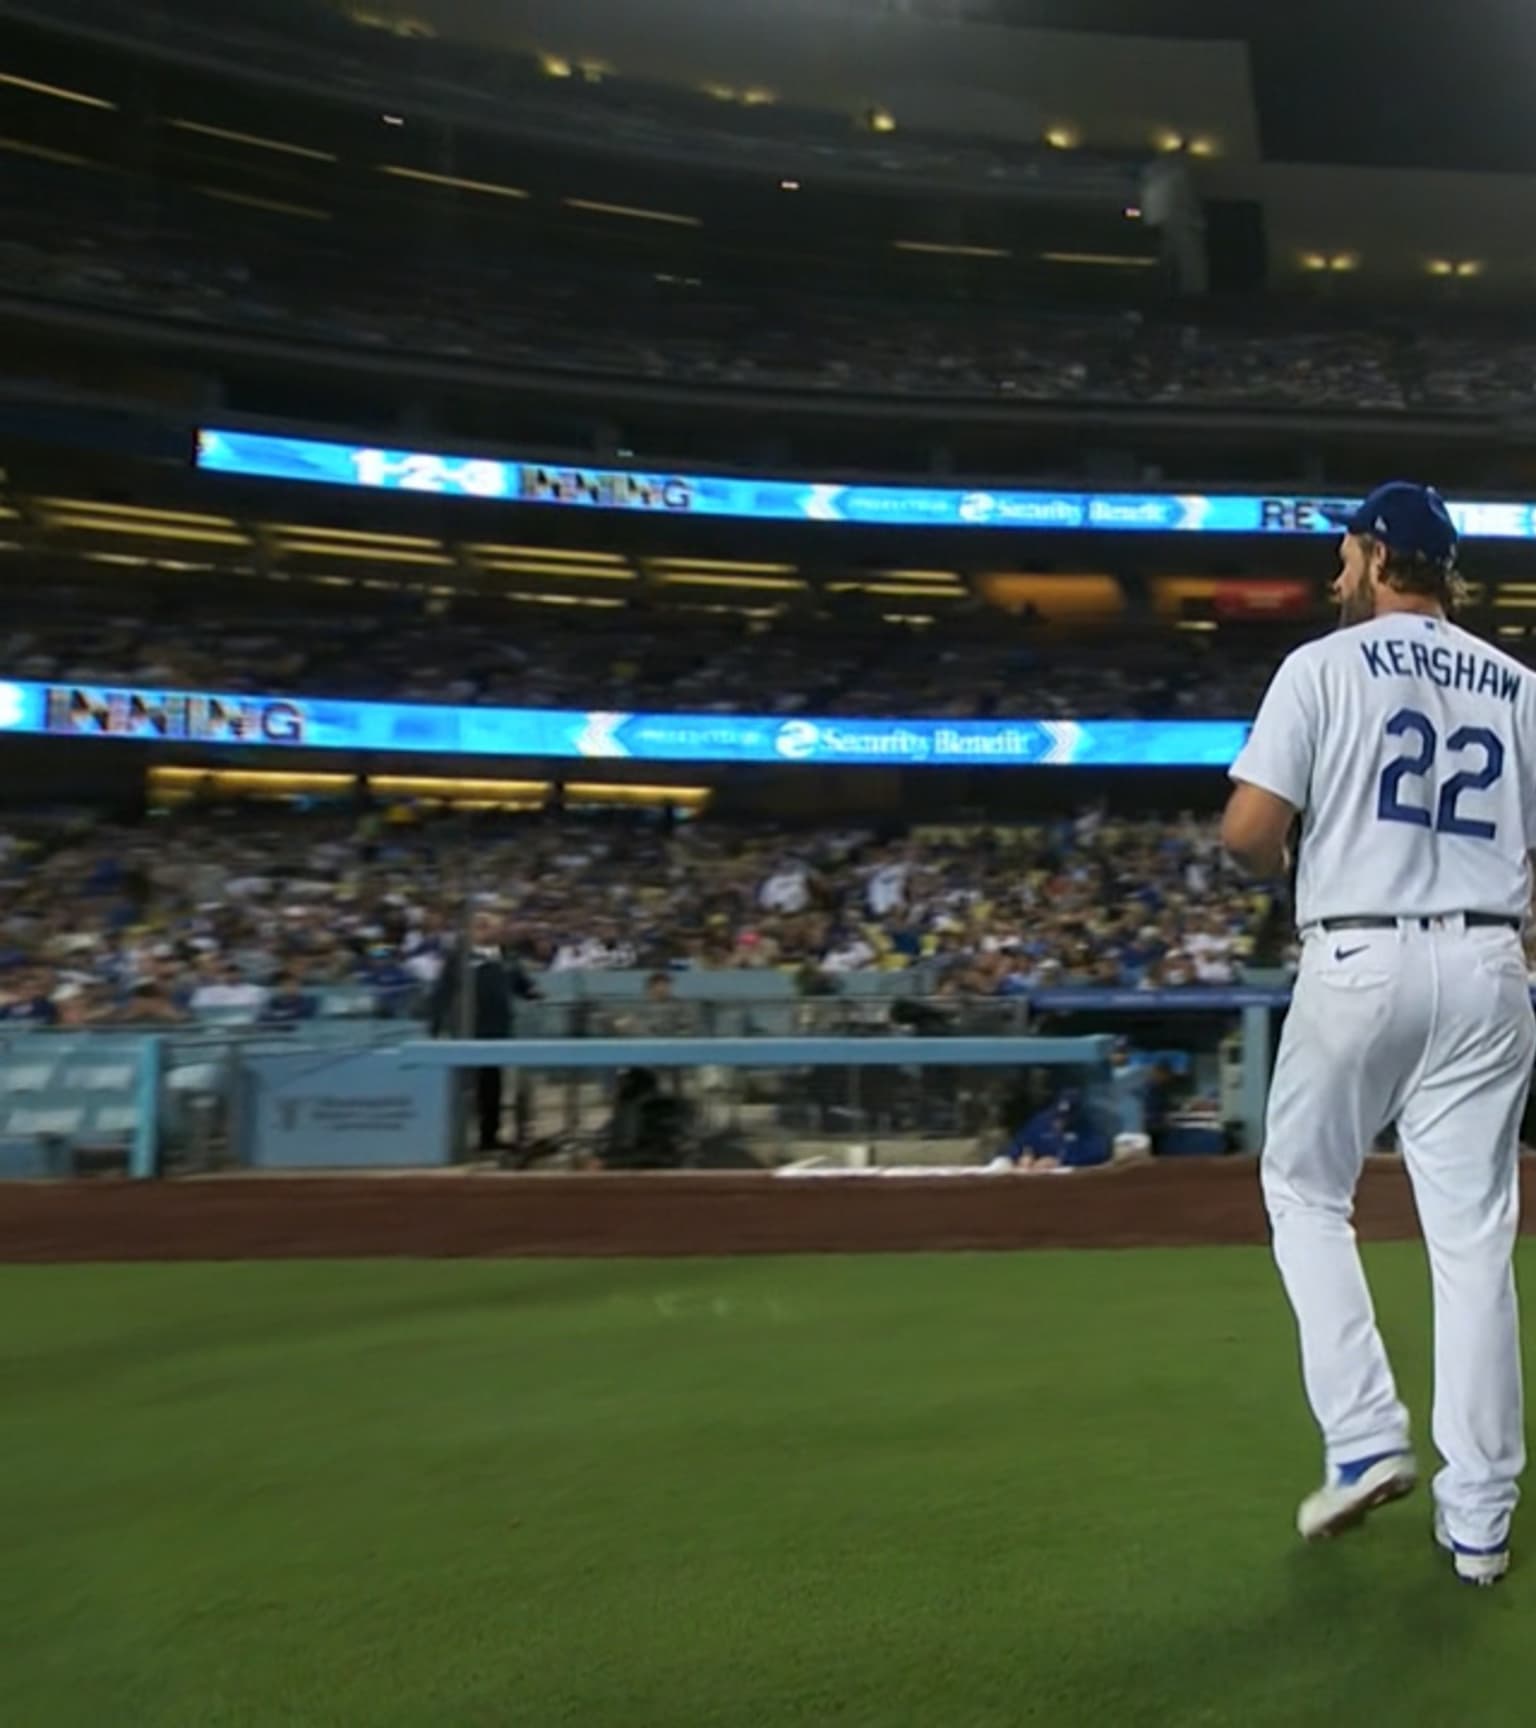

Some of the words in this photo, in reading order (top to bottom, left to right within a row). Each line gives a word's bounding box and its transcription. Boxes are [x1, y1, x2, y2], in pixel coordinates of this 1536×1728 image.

[351, 448, 504, 496] 1-2-3
[1361, 640, 1522, 703] KERSHAW
[44, 685, 304, 744] INNING
[820, 729, 927, 759] Security
[1376, 708, 1505, 840] 22
